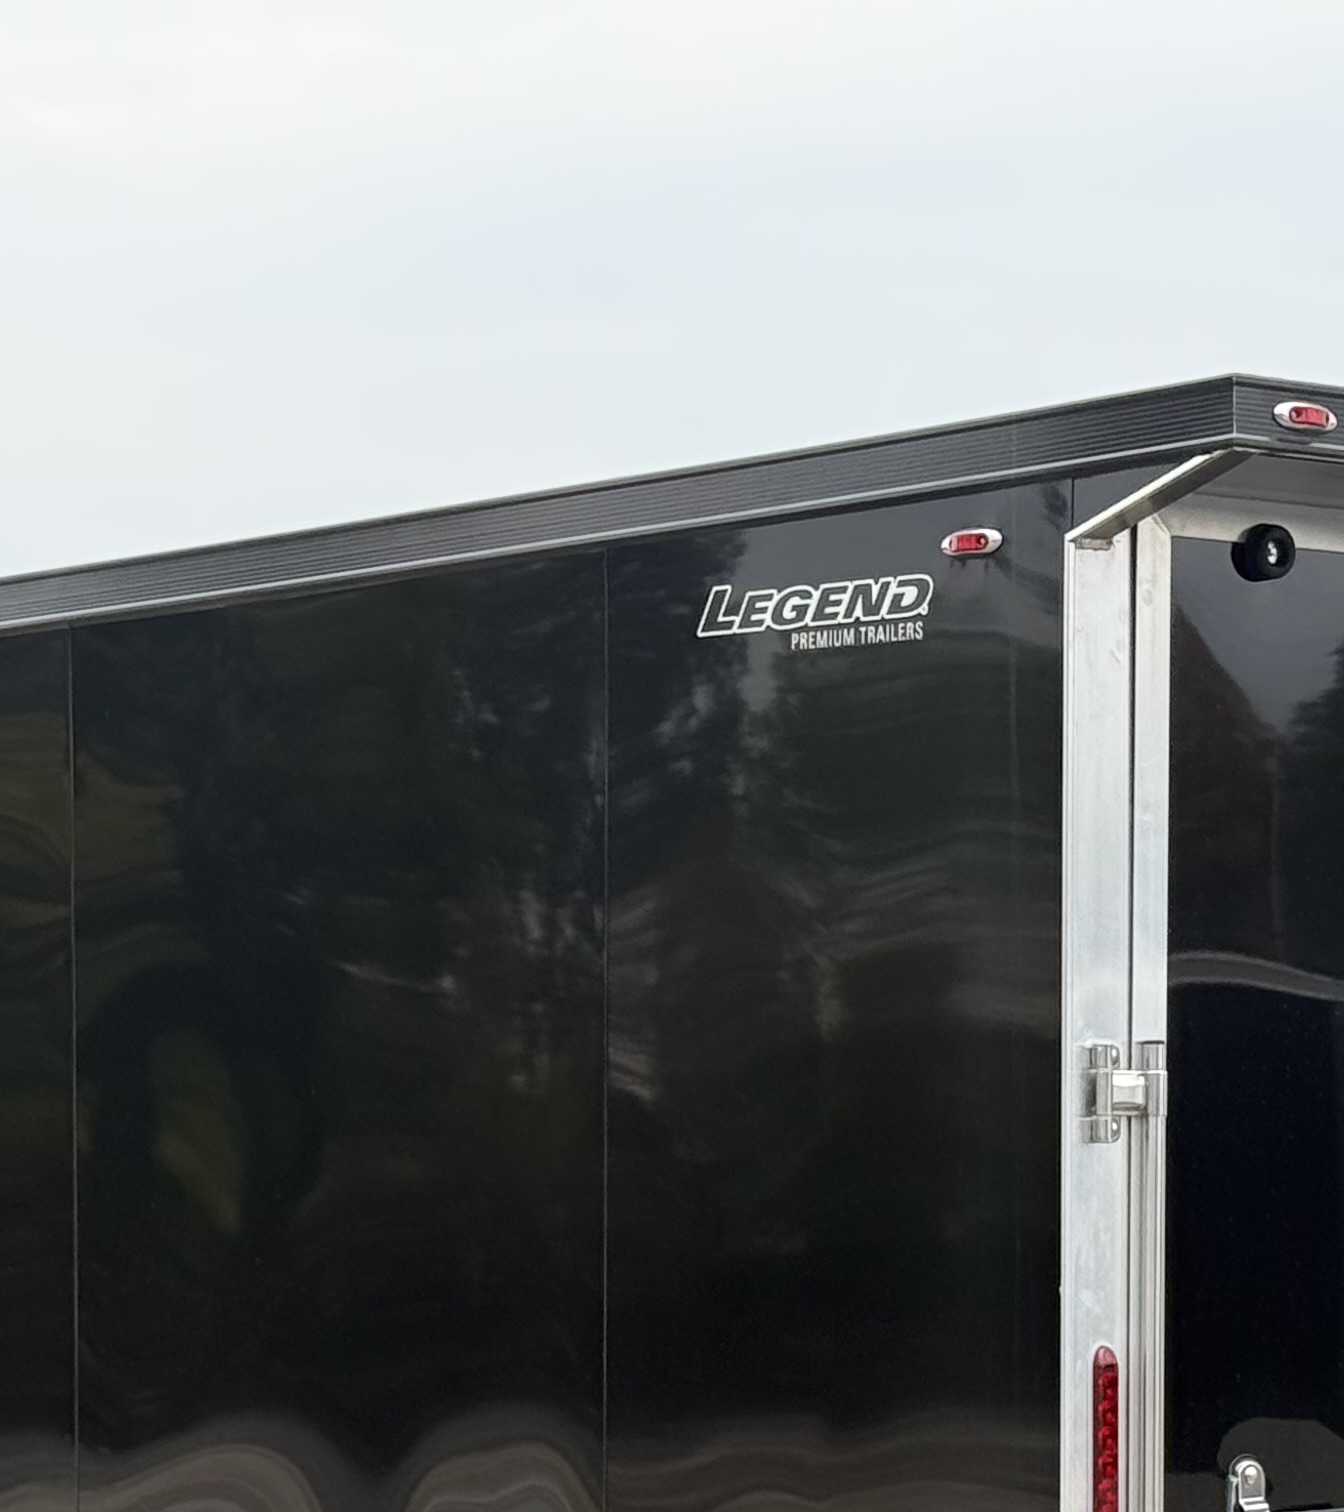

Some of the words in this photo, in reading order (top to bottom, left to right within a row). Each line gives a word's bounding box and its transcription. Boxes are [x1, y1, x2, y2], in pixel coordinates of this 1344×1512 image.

[697, 574, 934, 638] LEGEND
[791, 626, 856, 651] PREMIUM
[860, 621, 924, 647] TRAILERS
